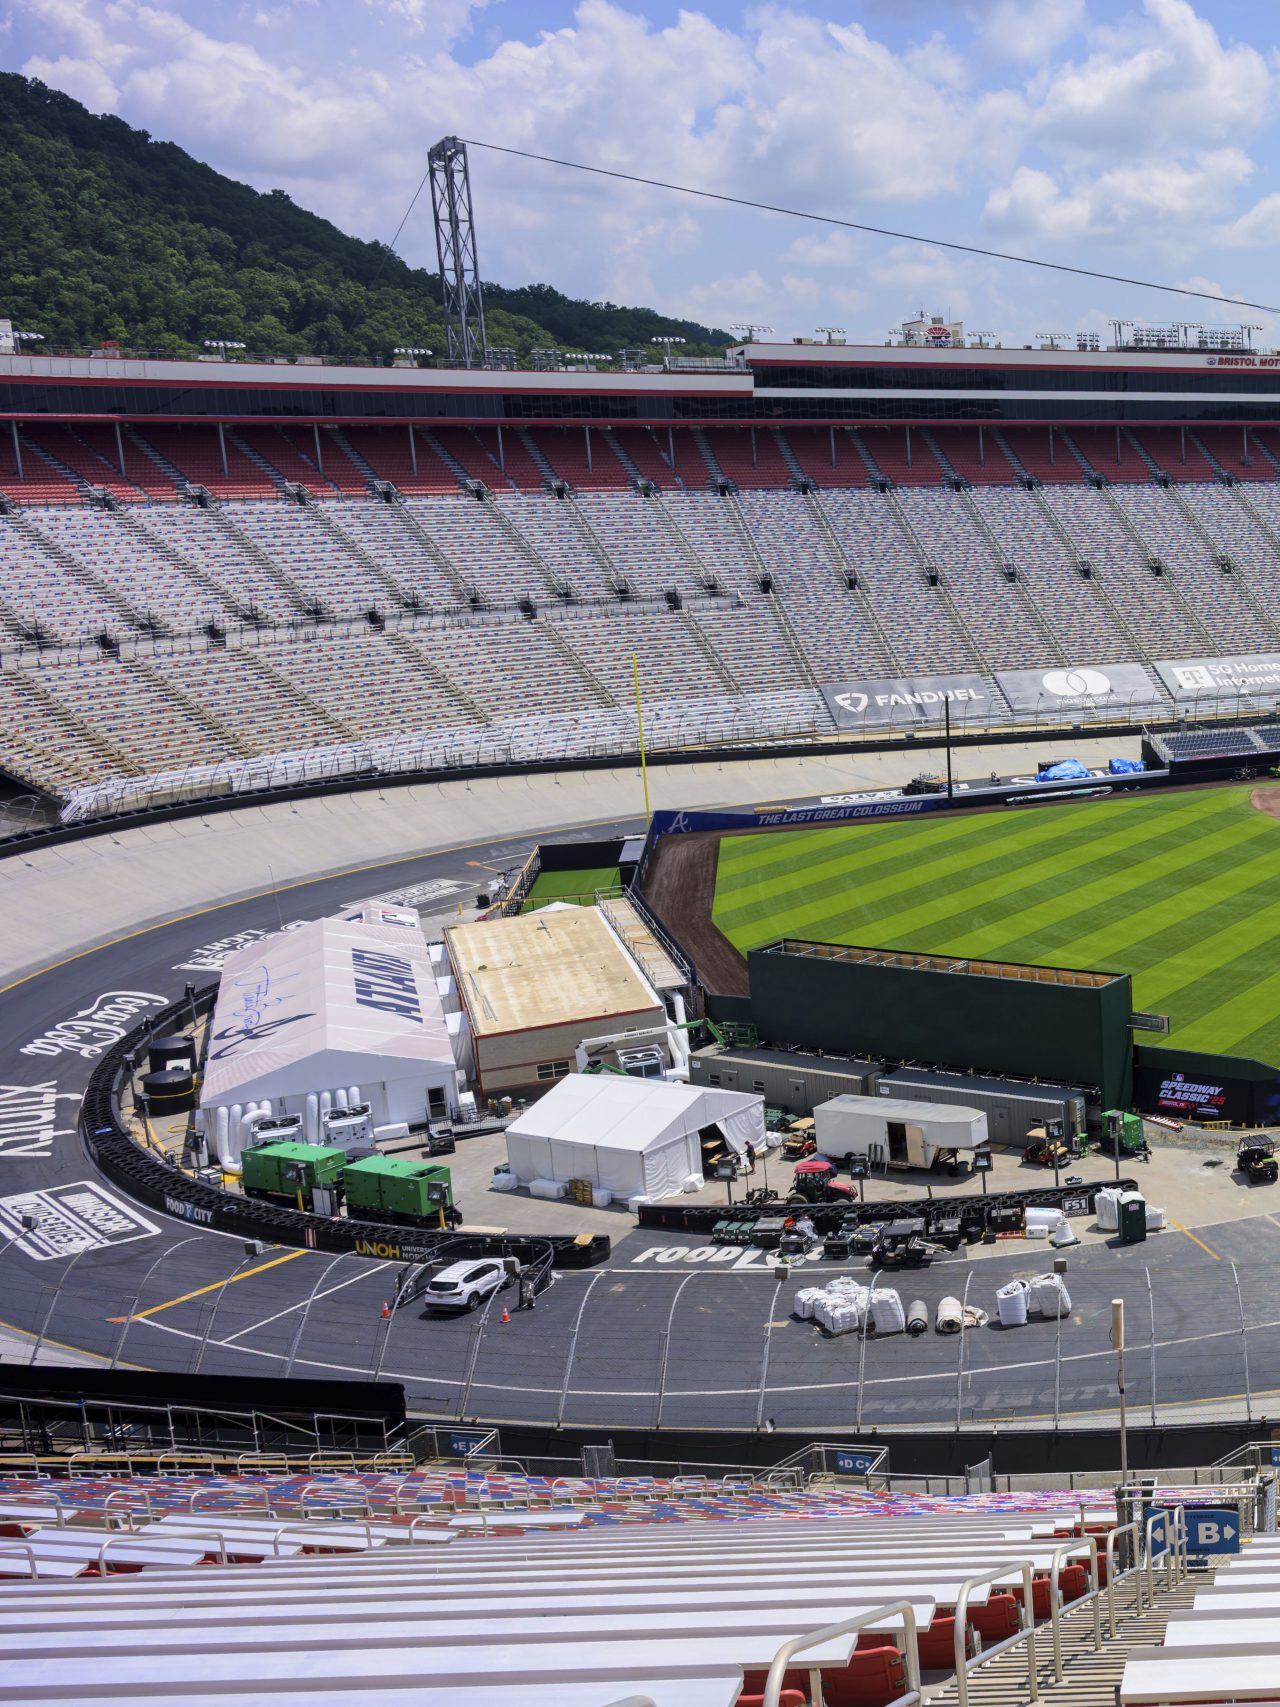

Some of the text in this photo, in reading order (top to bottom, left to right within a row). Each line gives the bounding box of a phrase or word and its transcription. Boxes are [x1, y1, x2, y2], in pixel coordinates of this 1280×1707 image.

[1217, 357, 1257, 367] BRISTOL
[1208, 664, 1233, 675] 5G
[874, 687, 985, 707] FANDUEL
[758, 801, 923, 825] THE LAST GREAT COLOSSEUM
[193, 928, 264, 956] LIGHT
[351, 947, 424, 1024] ATLANTA
[19, 990, 170, 1059] Coca-Cola
[1159, 1089, 1227, 1105] CLASSIC '25
[1160, 1080, 1224, 1096] SPEEDWAY
[166, 1197, 213, 1223] FOOD CITY
[1064, 1199, 1086, 1211] FS1
[355, 1239, 400, 1258] UNOH
[630, 1246, 744, 1263] FOOD
[458, 1441, 467, 1451] E
[844, 1459, 865, 1469] D C
[1198, 1522, 1220, 1545] B
